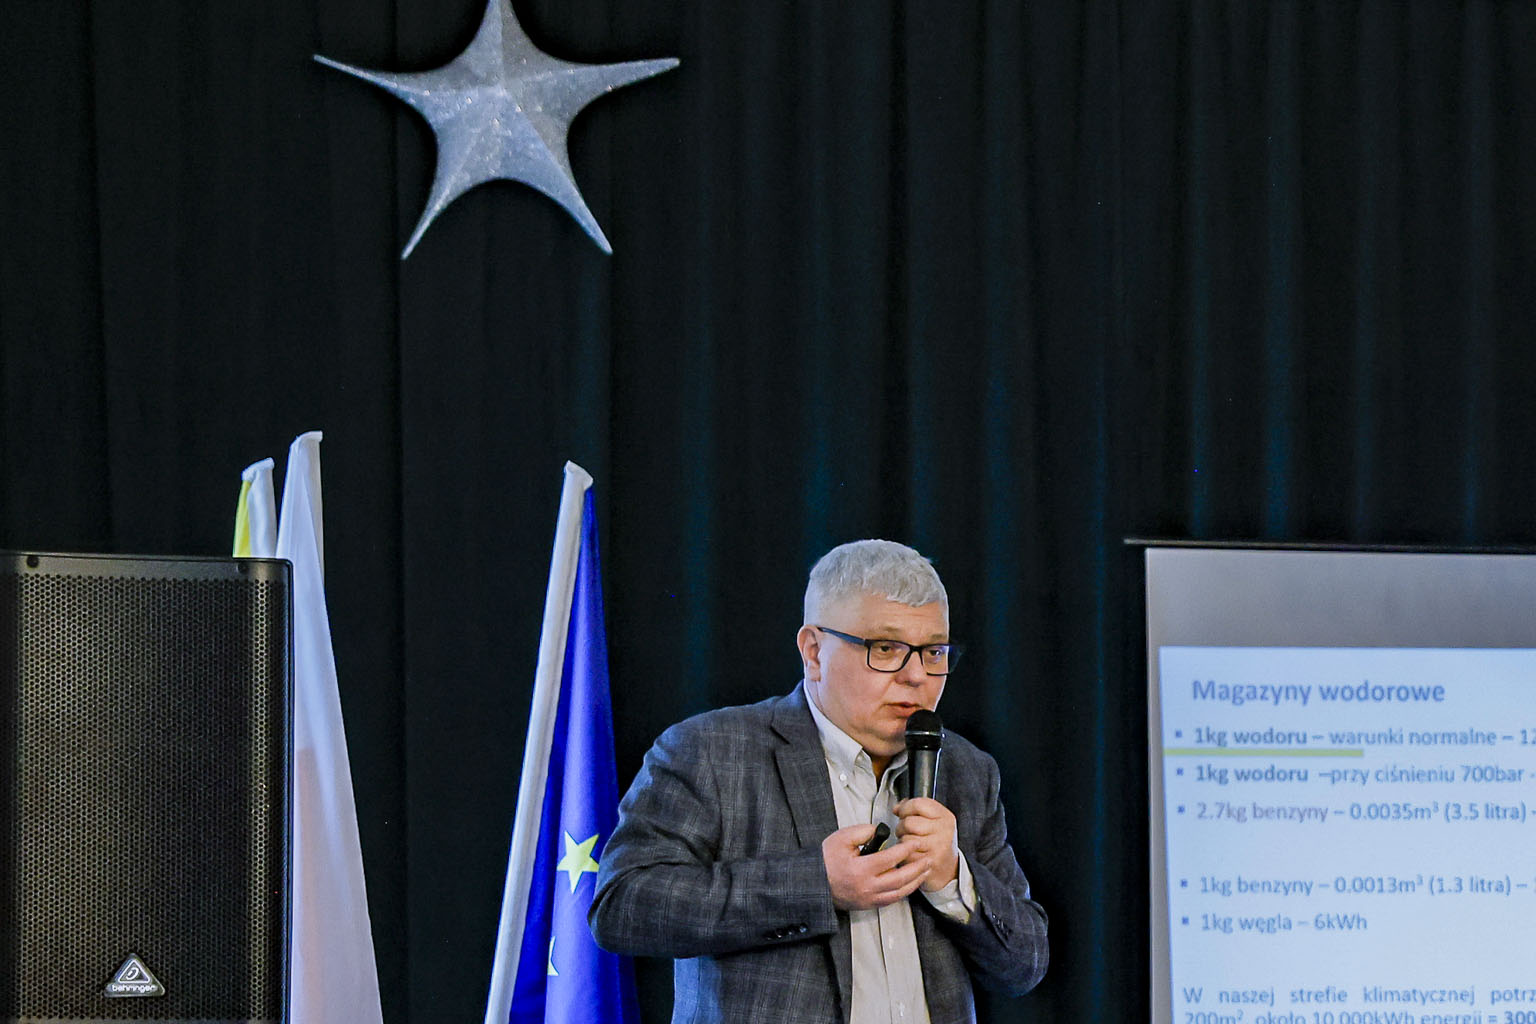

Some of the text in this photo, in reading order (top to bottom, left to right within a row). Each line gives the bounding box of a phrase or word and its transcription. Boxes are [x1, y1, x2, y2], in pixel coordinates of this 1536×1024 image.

[1191, 680, 1445, 707] Magazyny wodorowe
[1195, 726, 1228, 748] 1kg
[1233, 727, 1308, 745] wodoru
[1328, 727, 1404, 745] warunki
[1408, 728, 1498, 746] normalne
[1196, 763, 1230, 786] 1kg
[1233, 764, 1309, 783] wodoru
[1374, 764, 1455, 783] ciśnieniu
[1460, 764, 1525, 783] 700bar
[1197, 801, 1248, 823] 2.7kg
[1252, 802, 1329, 824] benzyny
[1443, 801, 1480, 824] (3.5
[1484, 801, 1527, 824] litra)
[1200, 876, 1233, 897] 1kg
[1237, 876, 1314, 897] benzyny
[1428, 875, 1464, 896] (1.3
[1469, 875, 1512, 897] litra)
[1201, 913, 1368, 935] 1kg węgla 6kWh
[112, 984, 156, 993] behringer
[1182, 986, 1204, 1004] W
[1218, 987, 1275, 1007] naszej
[1289, 985, 1348, 1004] strefie
[1363, 985, 1475, 1007] klimatycznej
